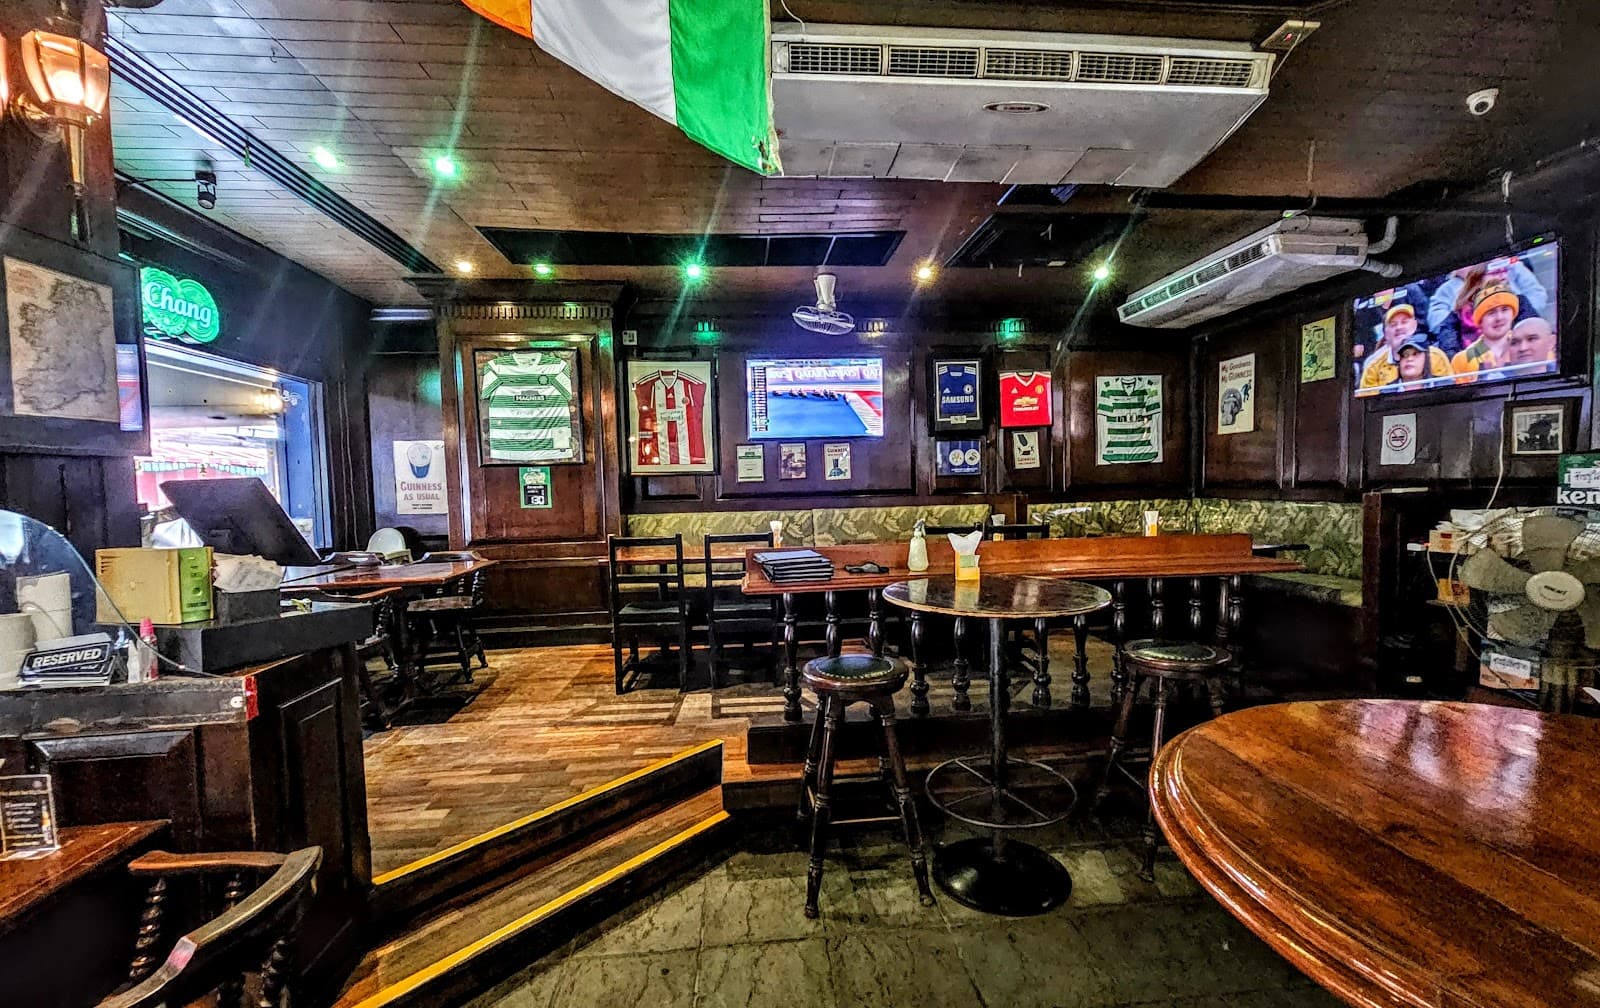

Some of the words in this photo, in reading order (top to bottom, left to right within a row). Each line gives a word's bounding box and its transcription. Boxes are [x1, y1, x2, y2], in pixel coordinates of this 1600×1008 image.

[144, 281, 212, 328] Chang
[942, 395, 975, 405] SAMSUNG
[400, 481, 442, 492] GUINNESS
[403, 493, 414, 501] AS
[416, 493, 441, 501] USUAL
[1557, 486, 1600, 505] ken
[32, 648, 102, 669] RESERVED
